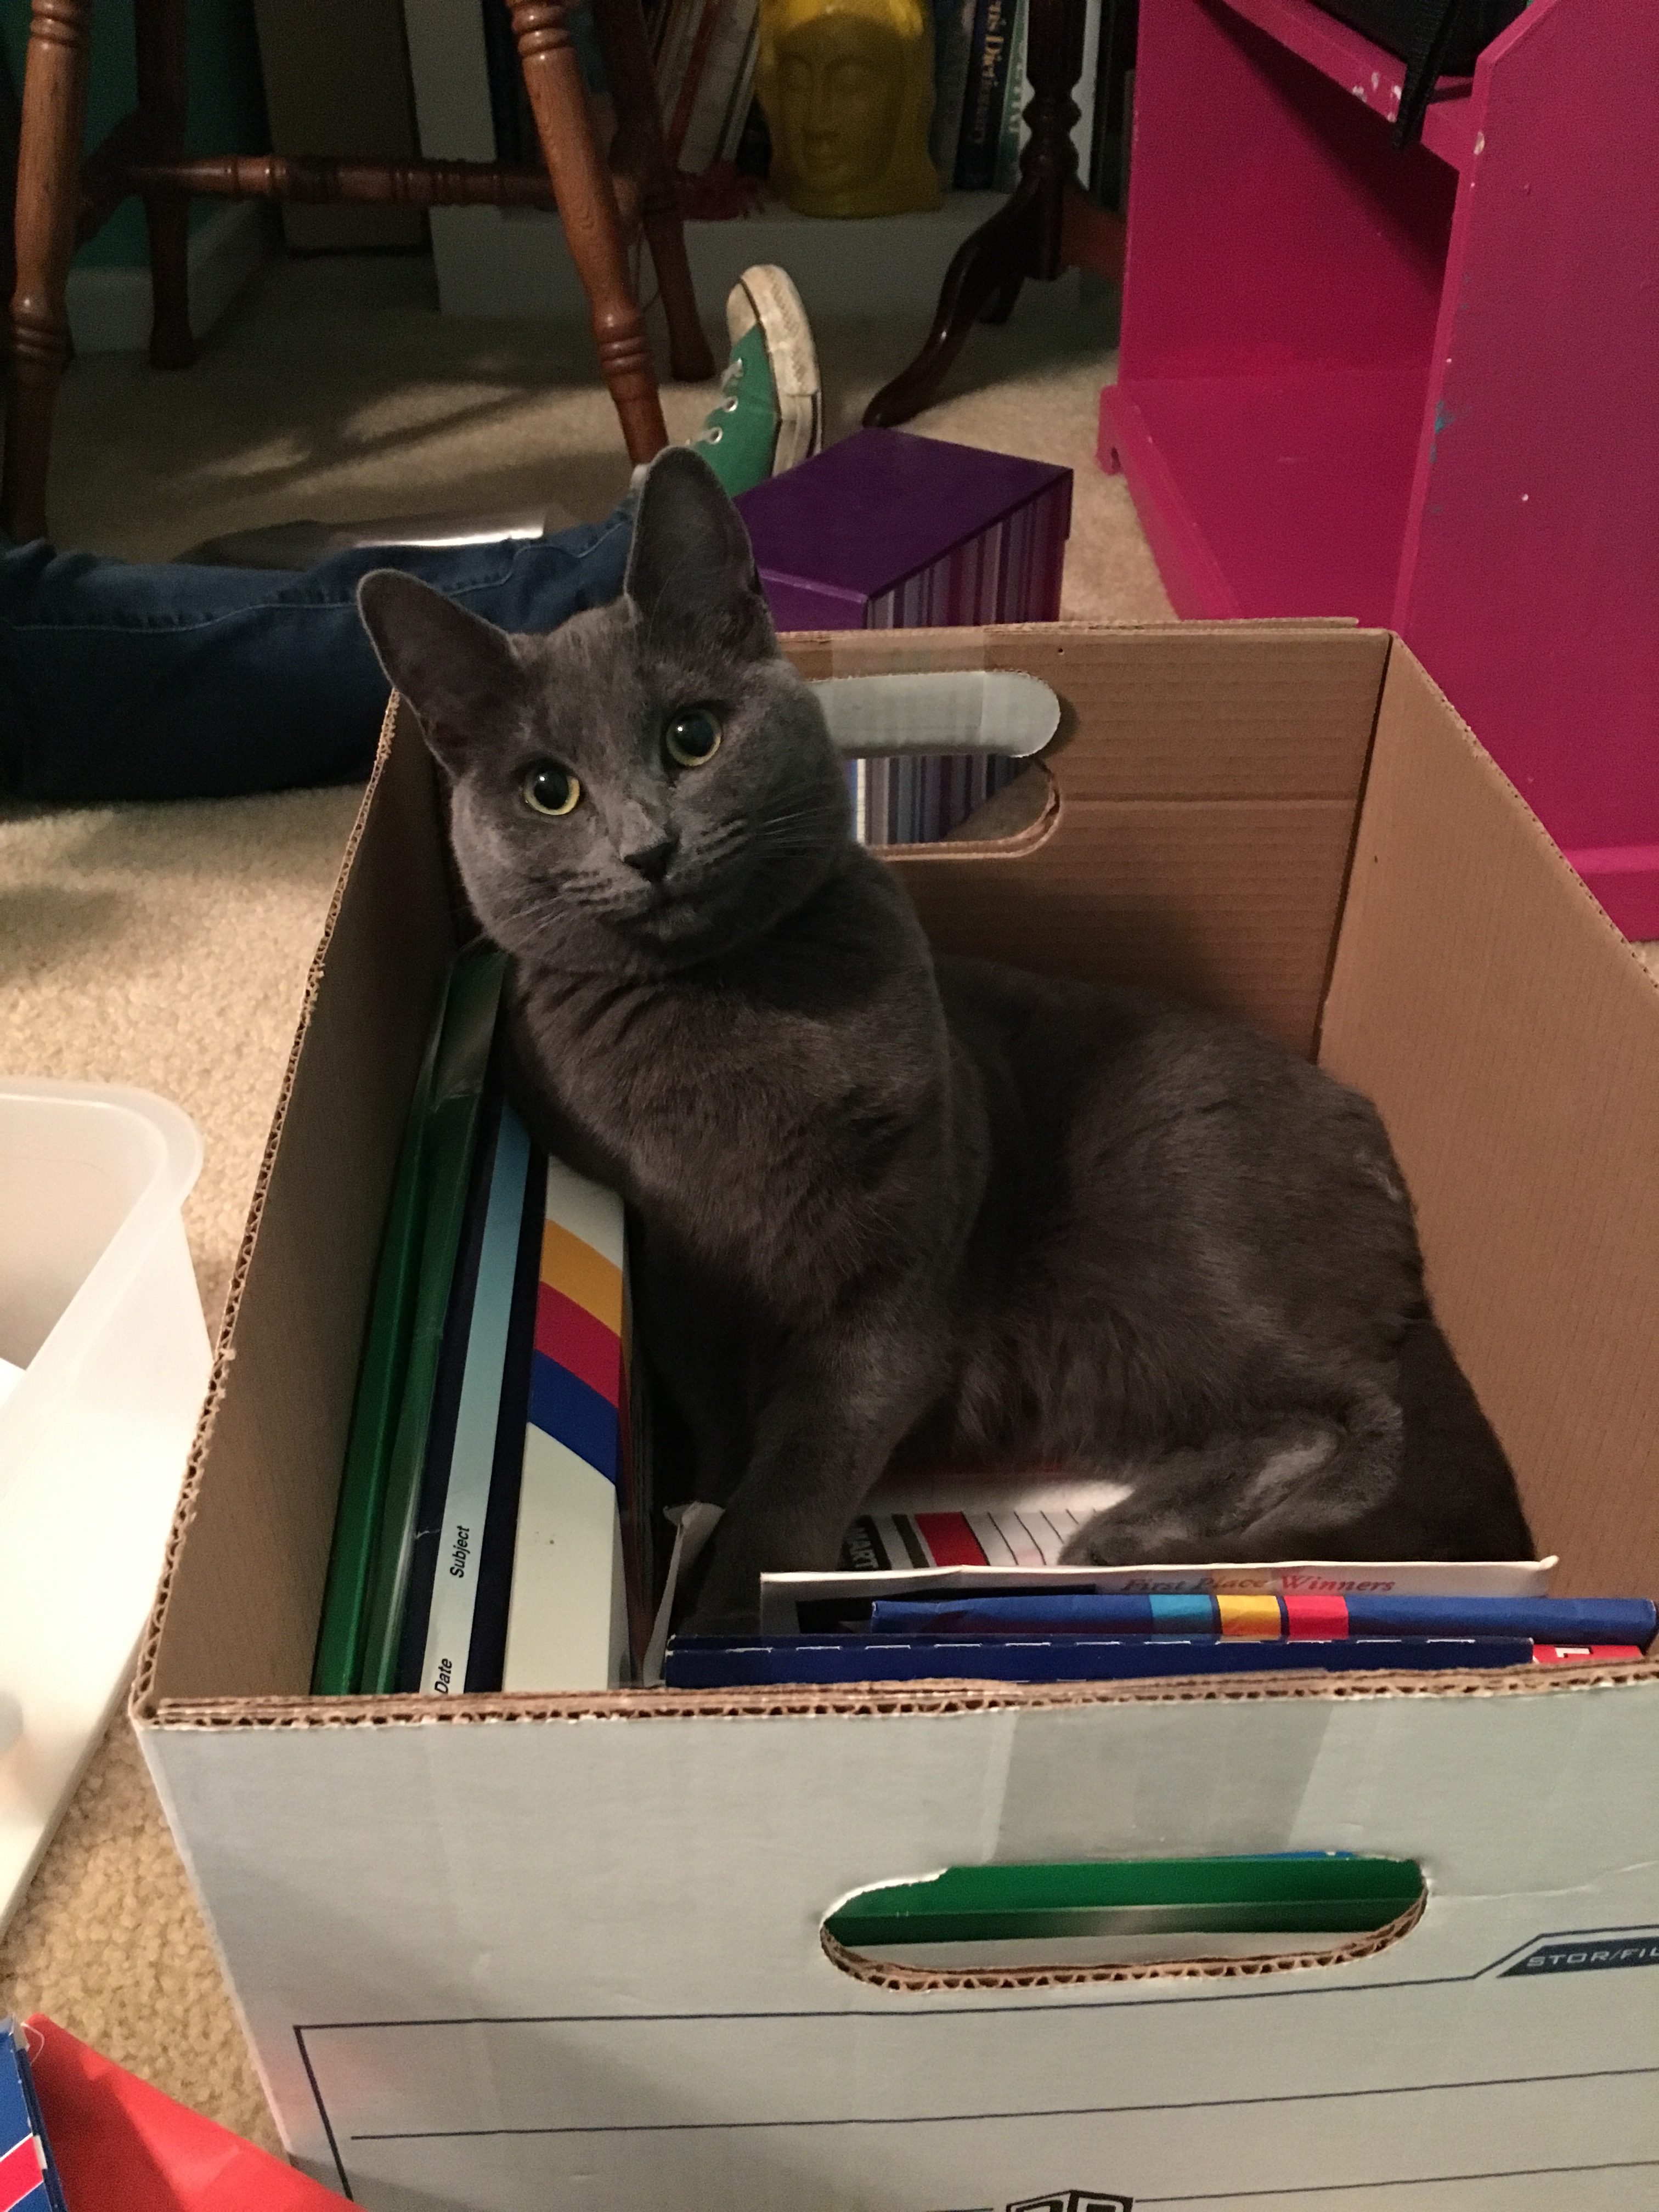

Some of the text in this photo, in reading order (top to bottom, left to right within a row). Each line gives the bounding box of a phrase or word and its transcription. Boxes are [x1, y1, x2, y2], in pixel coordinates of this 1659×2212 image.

[450, 1525, 470, 1578] Subject
[1121, 1575, 1395, 1591] First Place Winners
[435, 1658, 452, 1694] Date
